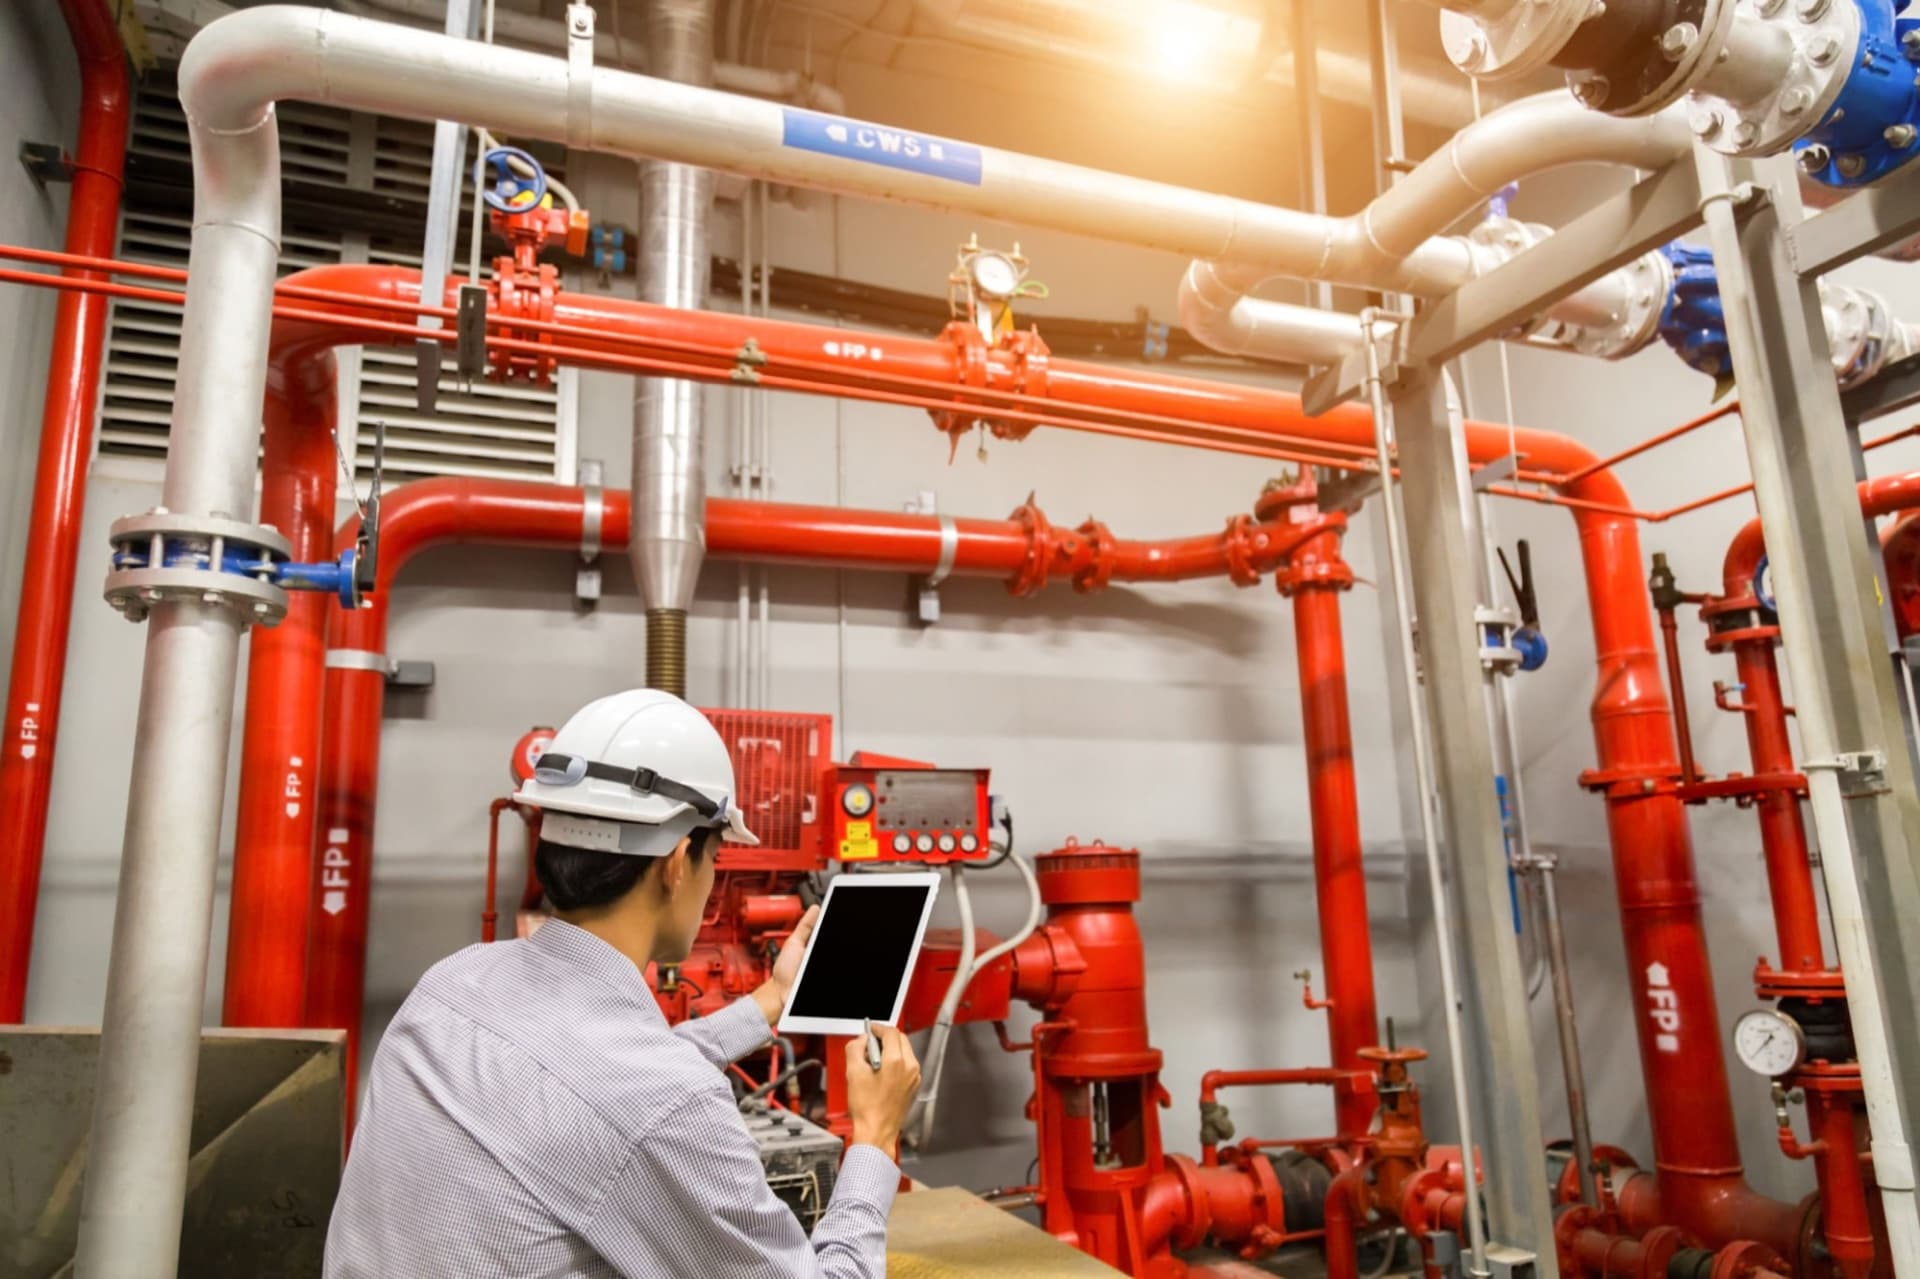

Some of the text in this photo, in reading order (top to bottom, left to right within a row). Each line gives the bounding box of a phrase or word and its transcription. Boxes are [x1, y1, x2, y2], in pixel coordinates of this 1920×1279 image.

[856, 128, 922, 158] CWS
[842, 342, 867, 360] FP
[20, 717, 39, 740] FP
[286, 772, 301, 797] FP
[322, 848, 351, 887] FP
[1647, 989, 1680, 1032] FP
